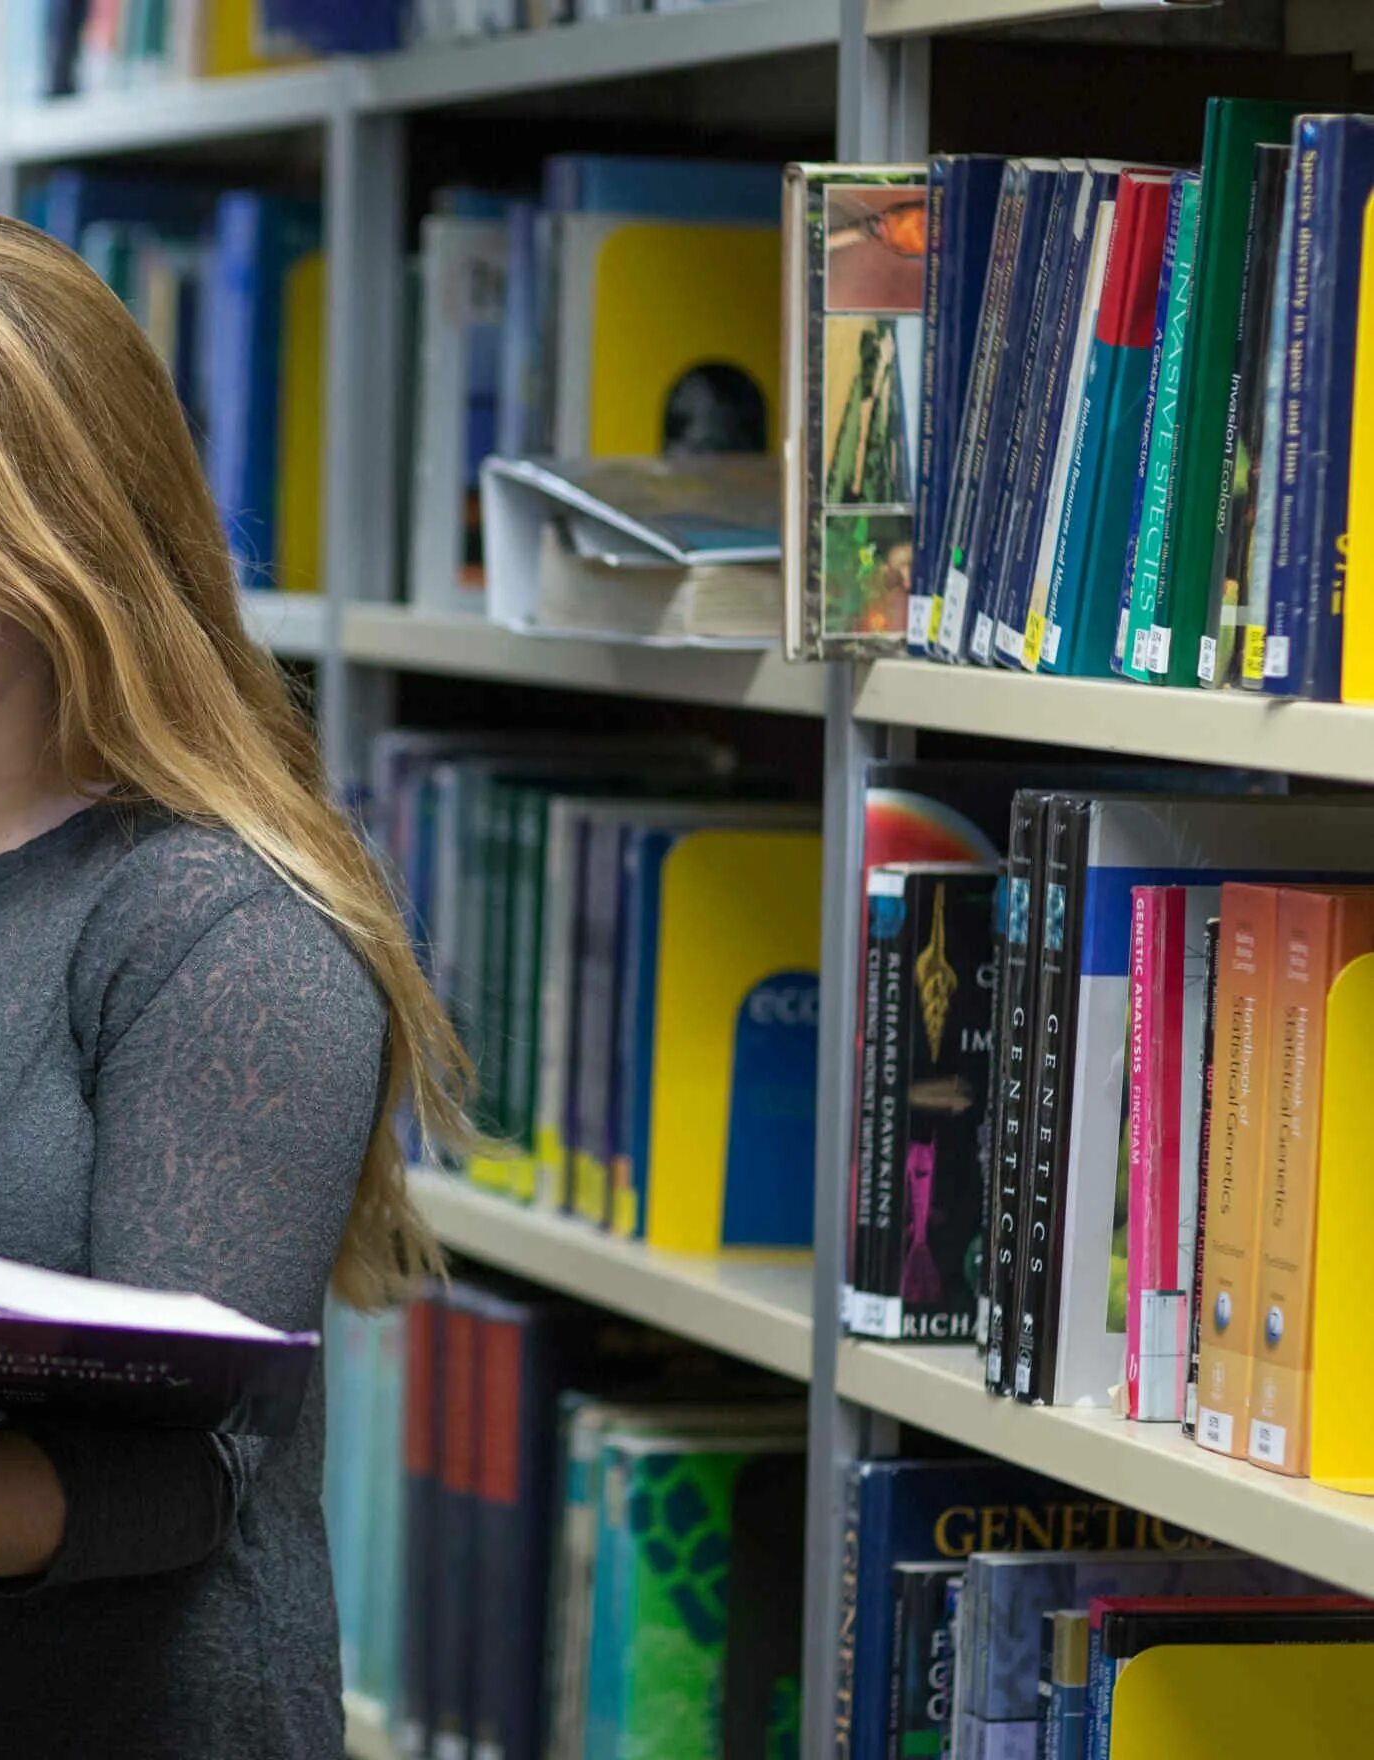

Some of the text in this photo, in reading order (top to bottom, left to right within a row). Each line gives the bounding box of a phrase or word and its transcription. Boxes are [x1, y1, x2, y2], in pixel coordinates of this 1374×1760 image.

[1159, 260, 1192, 447] INVASIVE
[1283, 149, 1317, 485] Species diversity in space and time
[1073, 397, 1092, 467] Biological
[1138, 327, 1163, 479] A Global Perspective
[1216, 373, 1242, 536] Invasion Ecology
[1055, 535, 1068, 565] and
[1062, 466, 1082, 535] Resources
[1139, 462, 1169, 611] SPECIES
[875, 951, 901, 1230] RICHARD DAWKINS
[1130, 897, 1145, 1165] GENETIC ANALYSIS FINCHAM
[1220, 994, 1245, 1214] Statistical Genetics
[1238, 996, 1256, 1125] Handbook of
[999, 1006, 1026, 1265] GENETICS
[1031, 1013, 1060, 1275] GENETICS
[1273, 1123, 1292, 1227] Genetics
